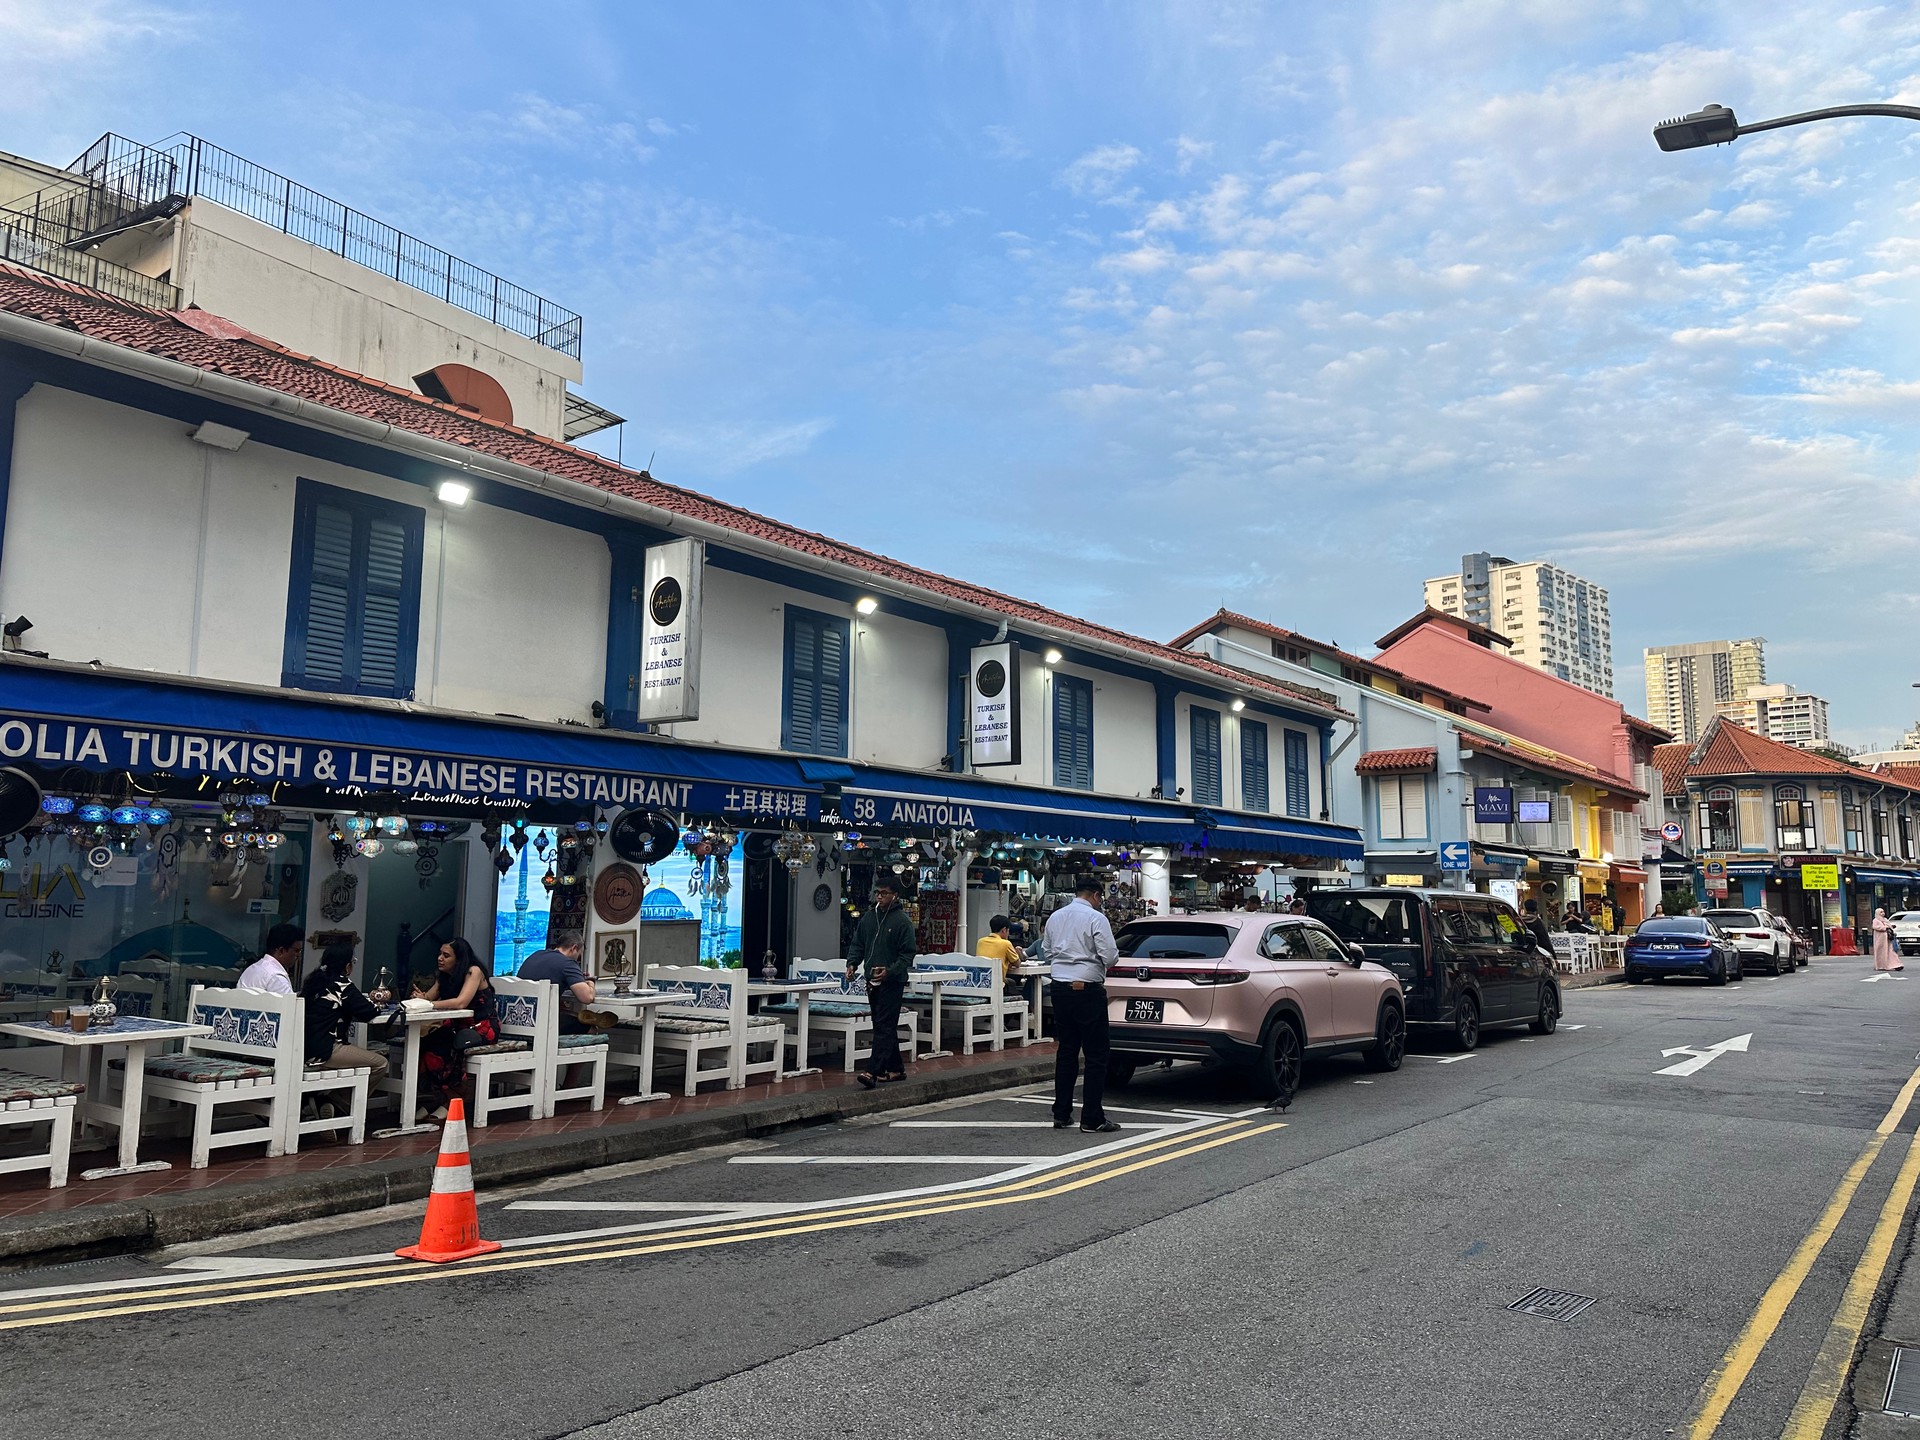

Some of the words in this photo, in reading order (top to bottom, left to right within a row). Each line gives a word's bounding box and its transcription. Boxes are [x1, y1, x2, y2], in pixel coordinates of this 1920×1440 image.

[649, 633, 681, 645] TURKISH
[661, 648, 668, 656] &
[645, 658, 682, 670] LEBANESE
[644, 677, 681, 688] RESTAURANT
[977, 703, 1006, 713] TURKISH
[975, 722, 1008, 731] LEBANESE
[975, 734, 1008, 743] RESTAURANT
[123, 730, 303, 778] TURKISH
[313, 749, 338, 781] &
[349, 751, 517, 795] LEBANESE
[526, 768, 693, 808] RESTAURANT
[724, 787, 806, 817] 土耳其料理
[1479, 803, 1508, 811] MAVI
[853, 797, 876, 820] 58
[891, 802, 975, 827] ANATOLIA
[5, 903, 84, 918] CUISINE
[1135, 1000, 1155, 1010] SNG
